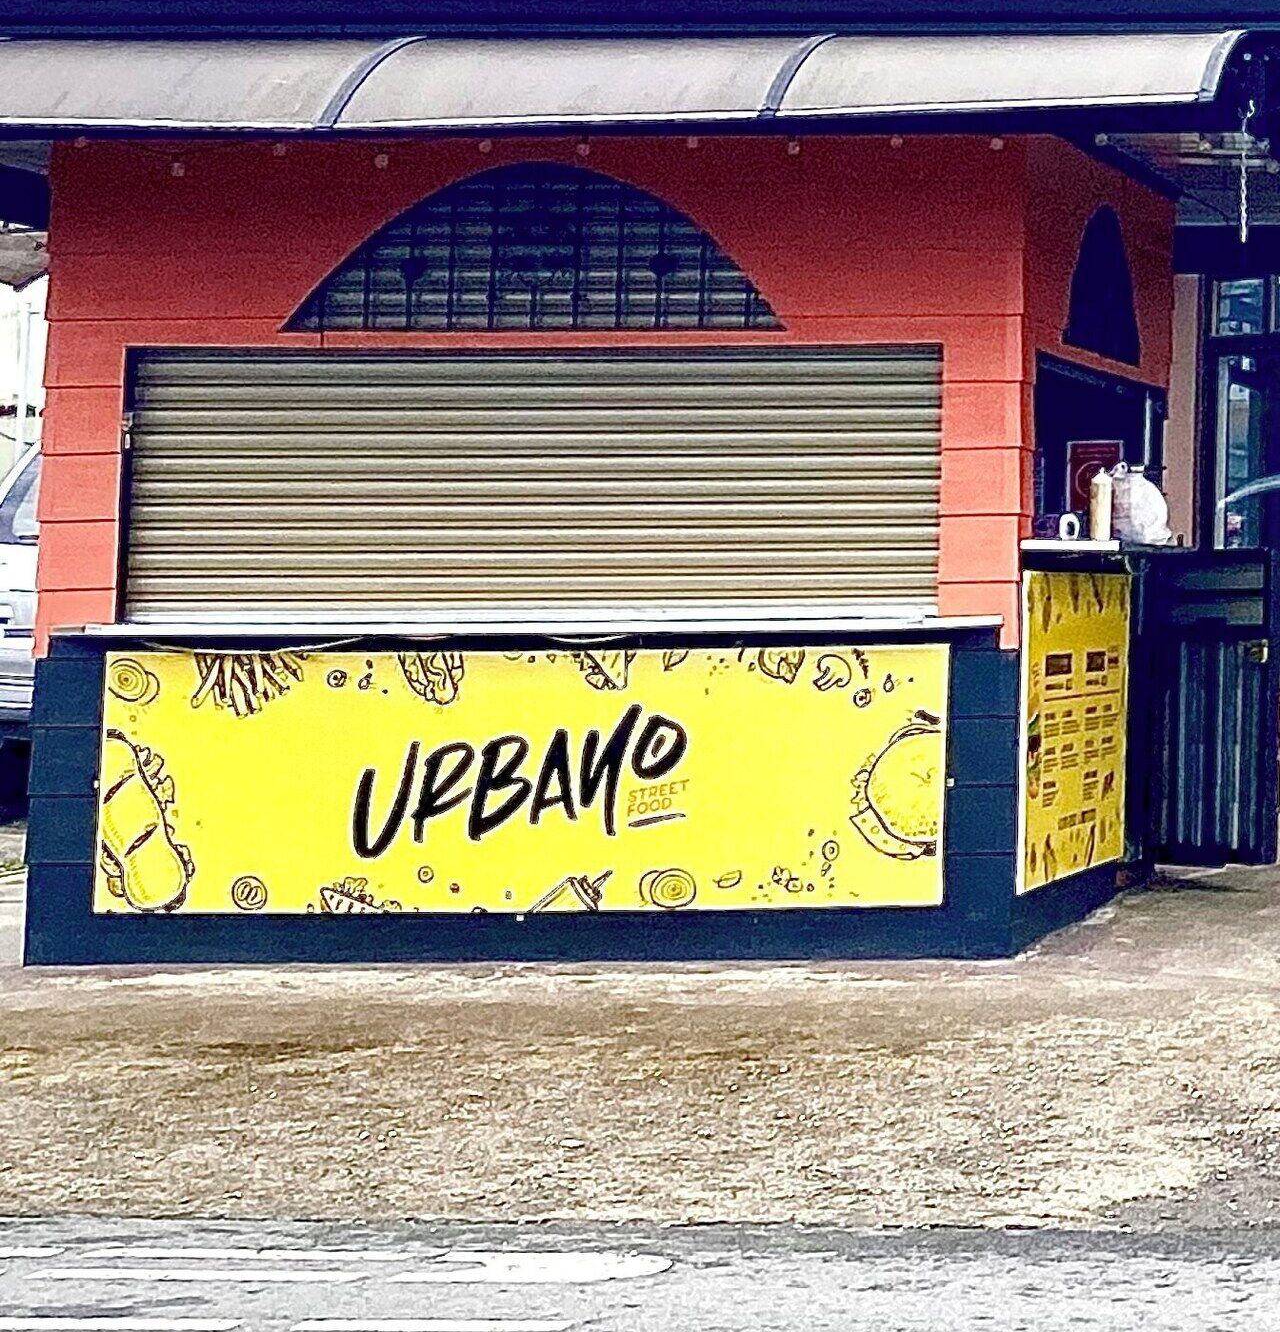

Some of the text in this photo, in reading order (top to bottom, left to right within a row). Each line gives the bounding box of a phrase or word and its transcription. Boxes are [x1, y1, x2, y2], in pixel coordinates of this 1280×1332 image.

[352, 704, 688, 859] URBANO
[627, 779, 691, 804] STREET
[626, 797, 673, 818] FOOD
